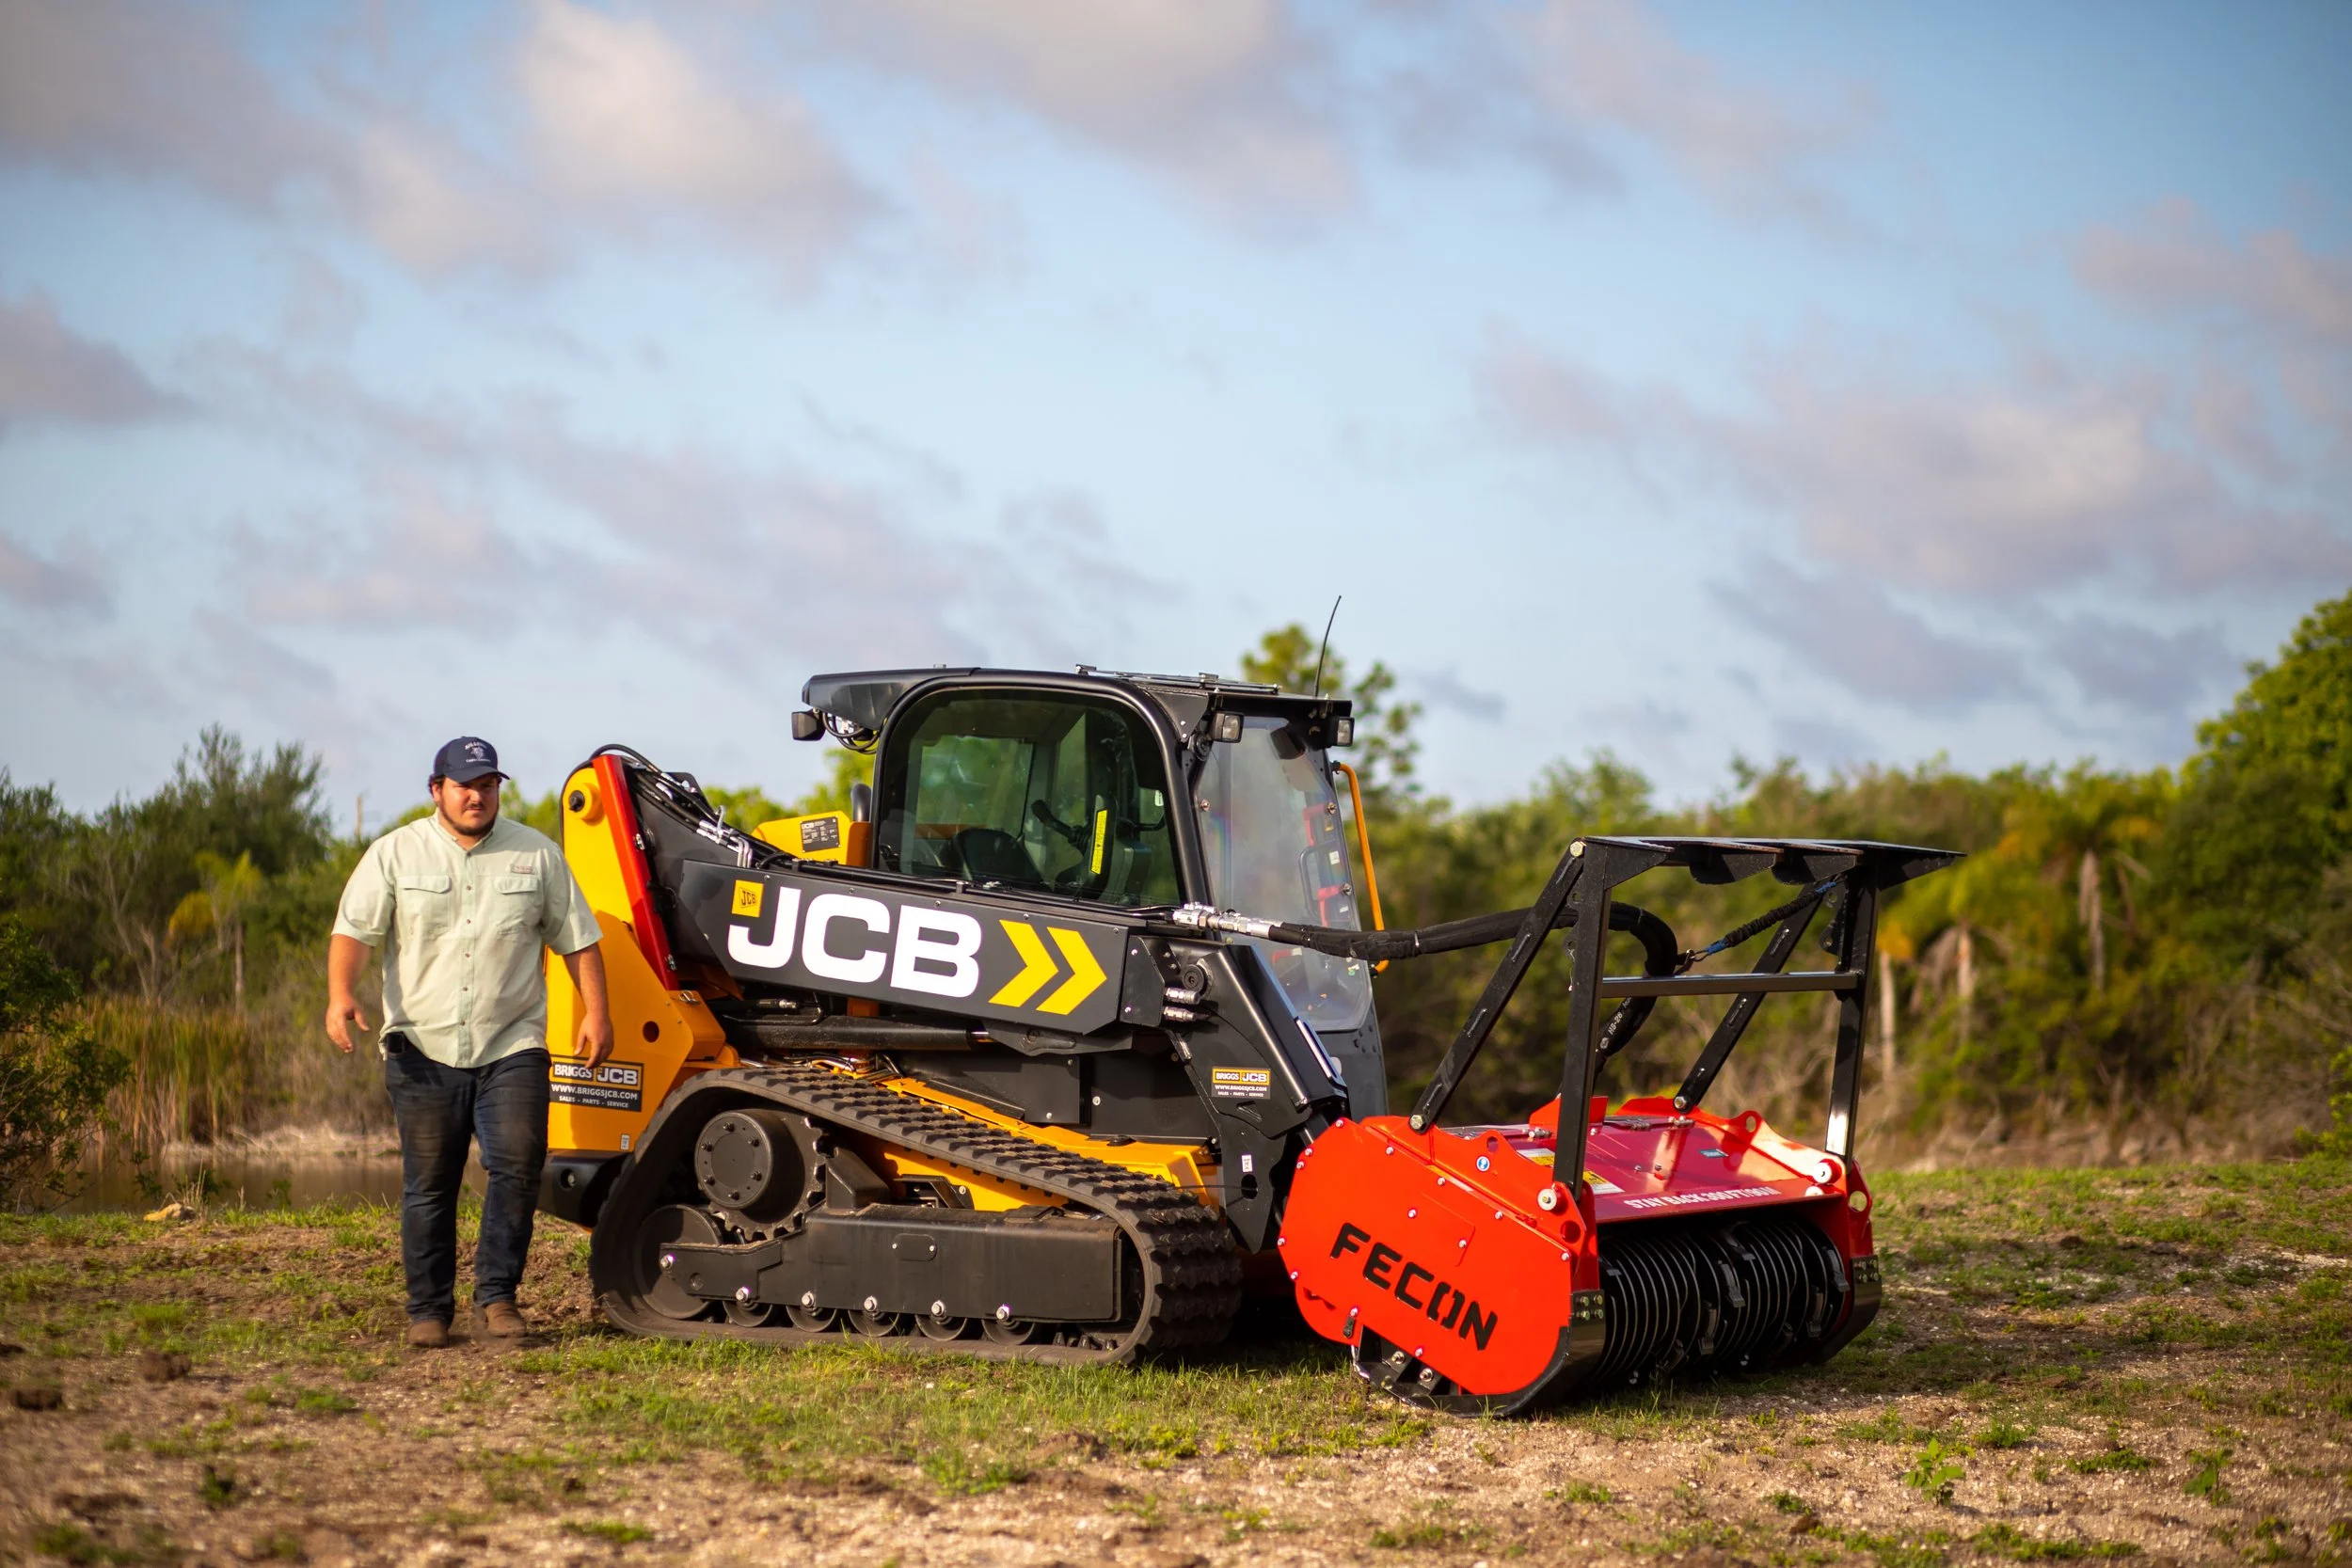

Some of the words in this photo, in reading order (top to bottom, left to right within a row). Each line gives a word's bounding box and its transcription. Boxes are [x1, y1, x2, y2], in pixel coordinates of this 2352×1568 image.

[741, 891, 756, 906] JCB
[727, 885, 982, 998] JCB
[554, 1064, 593, 1079] BRIGGS
[597, 1068, 638, 1085] JCB
[1216, 1072, 1240, 1081] BRIGGS
[1242, 1072, 1267, 1083] JCB
[551, 1084, 638, 1101] WWW.BRIGGSJCB.COM
[607, 1101, 629, 1109] SERVICE
[1623, 1196, 1668, 1209] STAY
[1661, 1193, 1710, 1205] BACK
[1330, 1222, 1498, 1351] FECON
